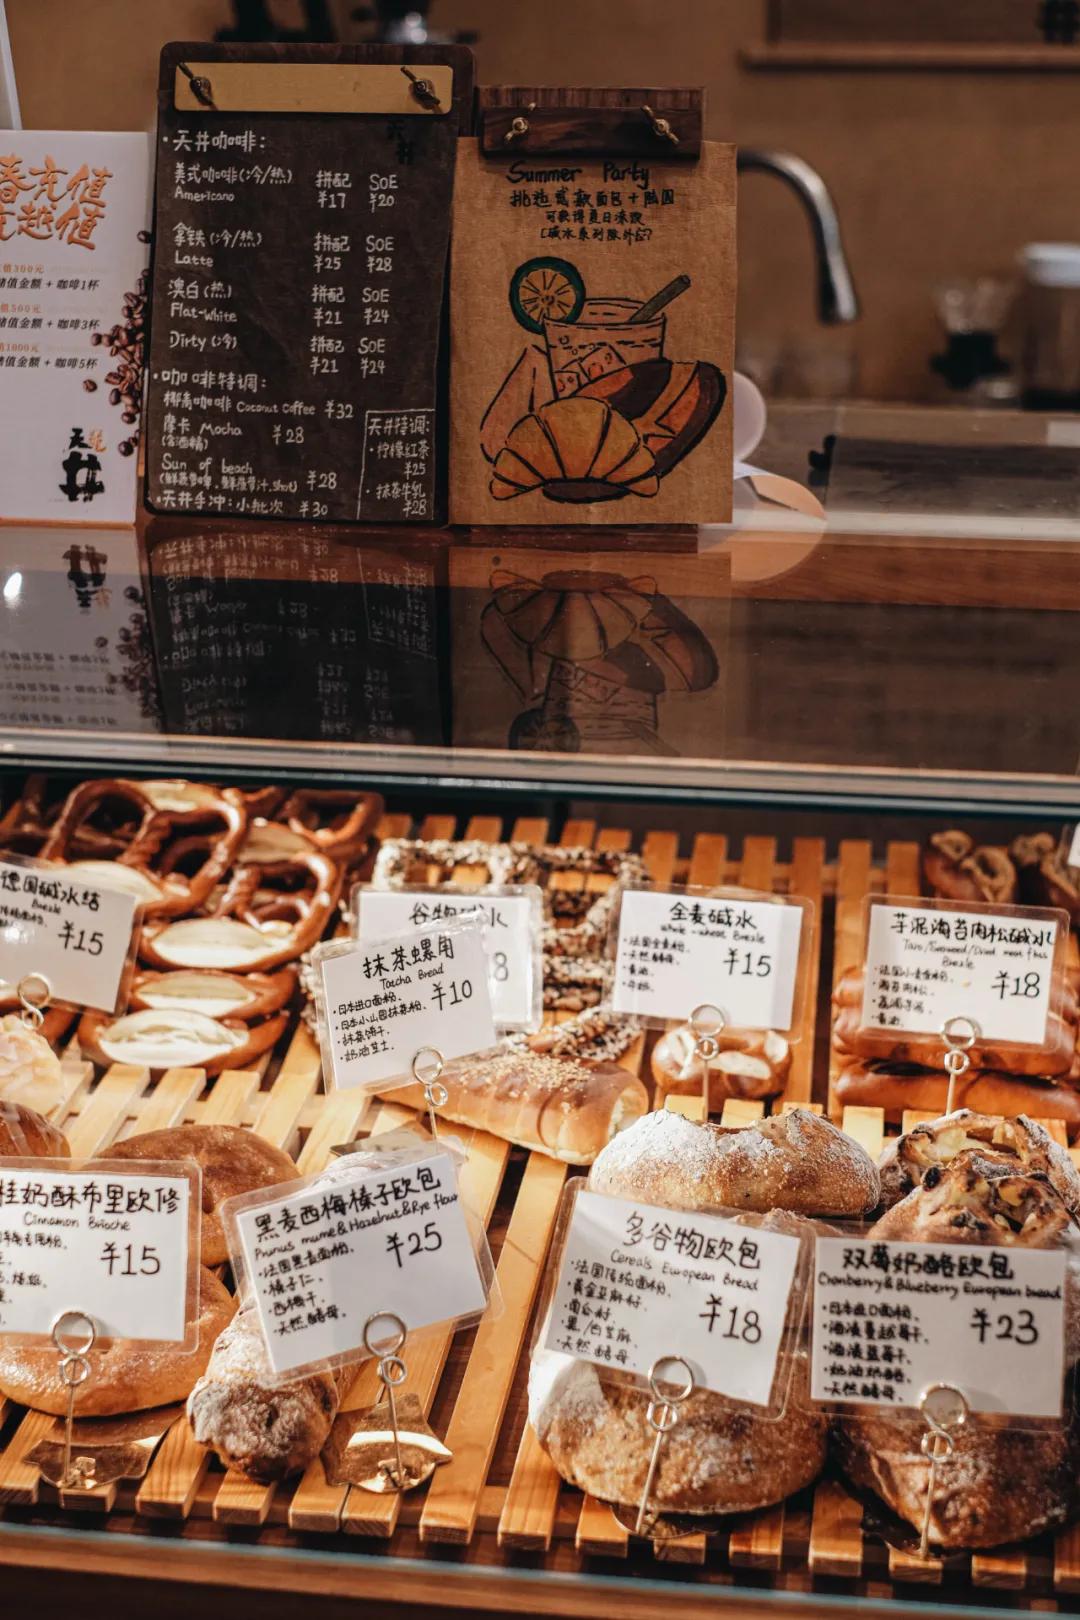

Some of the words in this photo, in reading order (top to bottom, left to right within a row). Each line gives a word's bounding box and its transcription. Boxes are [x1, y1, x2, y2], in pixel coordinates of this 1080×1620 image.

[316, 170, 351, 189] 拼配
[506, 160, 583, 184] Summer
[603, 161, 649, 190] Party
[174, 186, 235, 202] Americano
[317, 191, 346, 208] ¥17
[369, 193, 395, 213] ¥20
[314, 232, 350, 252] 拼配
[174, 251, 213, 267] Latte
[313, 255, 341, 273] ¥25
[367, 255, 392, 273] ¥28
[311, 284, 345, 303] 拼配
[313, 307, 342, 327] ¥21
[363, 307, 390, 326] ¥24
[169, 331, 207, 351] Dirty
[310, 336, 344, 353] 拼配
[310, 357, 339, 376] ¥21
[360, 358, 385, 378] ¥24
[236, 400, 278, 414] Coconut
[324, 401, 354, 418] ¥32
[200, 422, 243, 437] Mocha
[272, 424, 305, 445] ¥28
[161, 453, 187, 471] Sun
[199, 457, 212, 477] of
[222, 458, 252, 473] beach
[404, 461, 426, 481] ¥25
[307, 471, 338, 490] ¥28
[299, 501, 328, 517] ¥30
[669, 901, 758, 930] 全麦碱水
[58, 920, 104, 956] ¥15
[418, 963, 444, 980] Bread
[723, 947, 772, 977] ¥15
[431, 980, 473, 1011] ¥10
[991, 970, 1040, 1000] ¥18
[255, 1167, 441, 1243] 黑麦西梅榛子欧包
[23, 1211, 80, 1228] Cinnamon
[88, 1217, 131, 1231] Brioche
[386, 1222, 443, 1269] ¥25
[623, 1211, 761, 1270] 多谷物欧包
[100, 1241, 160, 1276] ¥15
[662, 1264, 715, 1283] European
[723, 1273, 759, 1291] Bread
[963, 1281, 1022, 1299] European
[699, 1293, 762, 1344] ¥18
[970, 1307, 1039, 1345] ¥23
